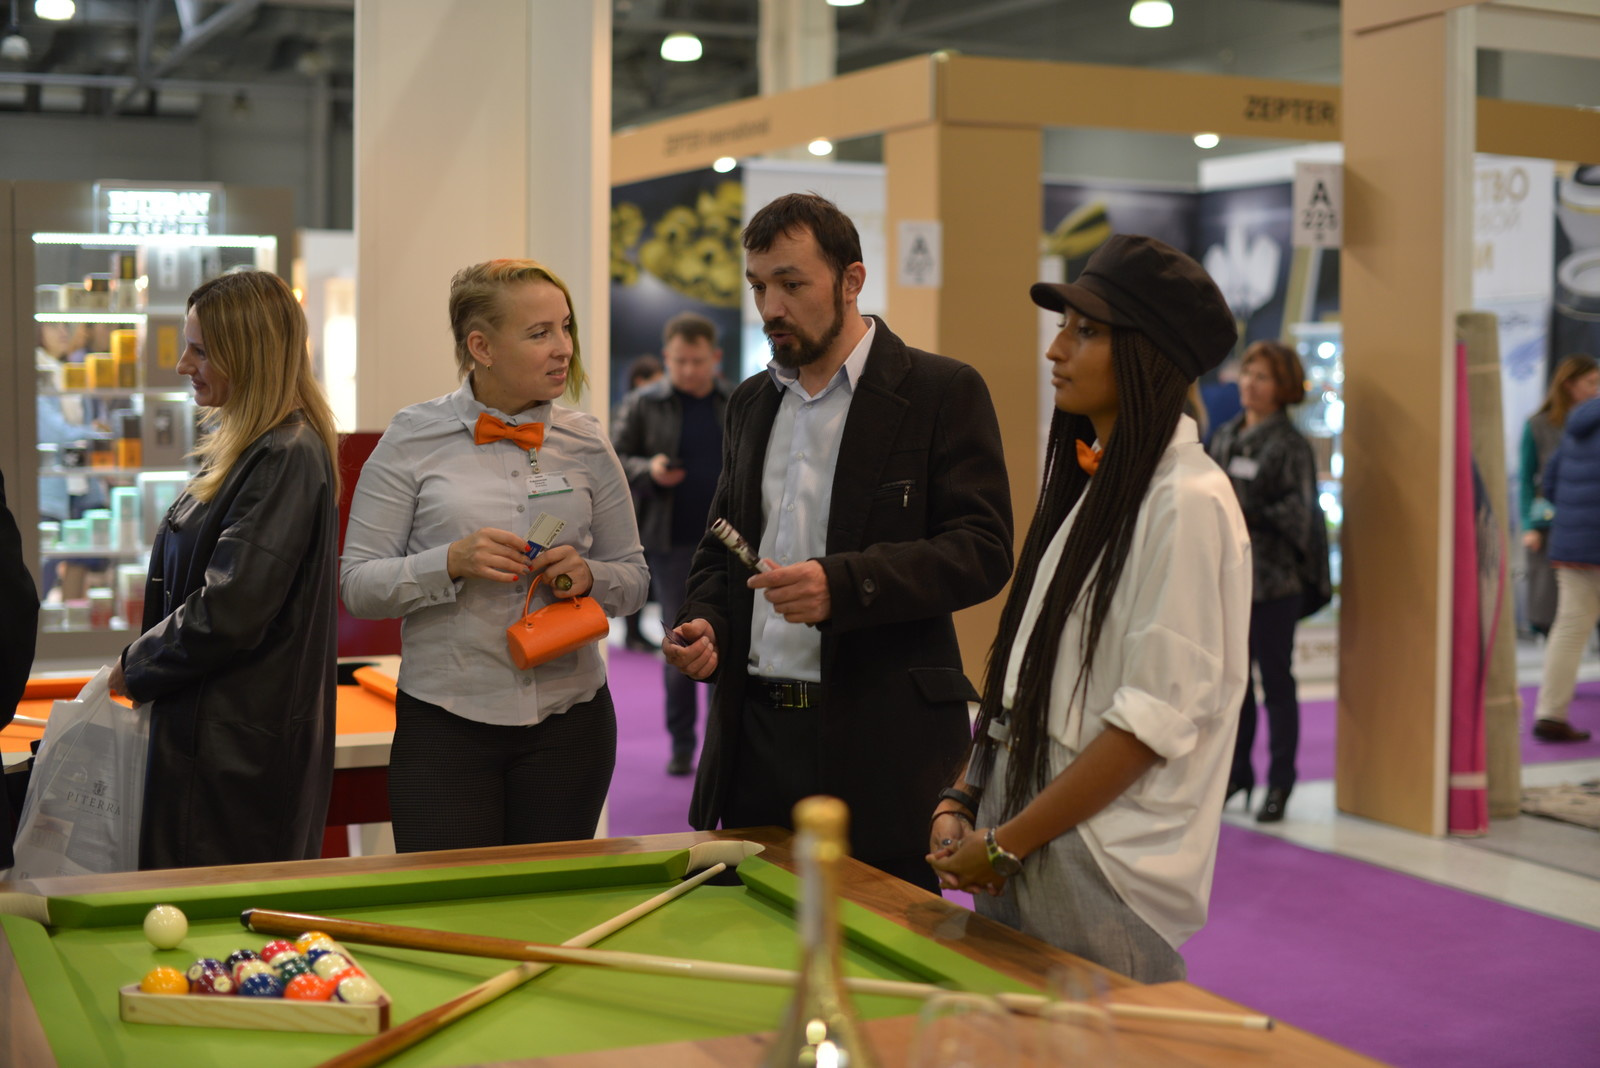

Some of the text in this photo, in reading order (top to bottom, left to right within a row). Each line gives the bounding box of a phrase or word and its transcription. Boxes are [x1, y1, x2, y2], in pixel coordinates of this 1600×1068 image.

[1243, 95, 1336, 125] ZEPTER
[1310, 180, 1332, 208] A
[67, 791, 121, 816] PITERRA
